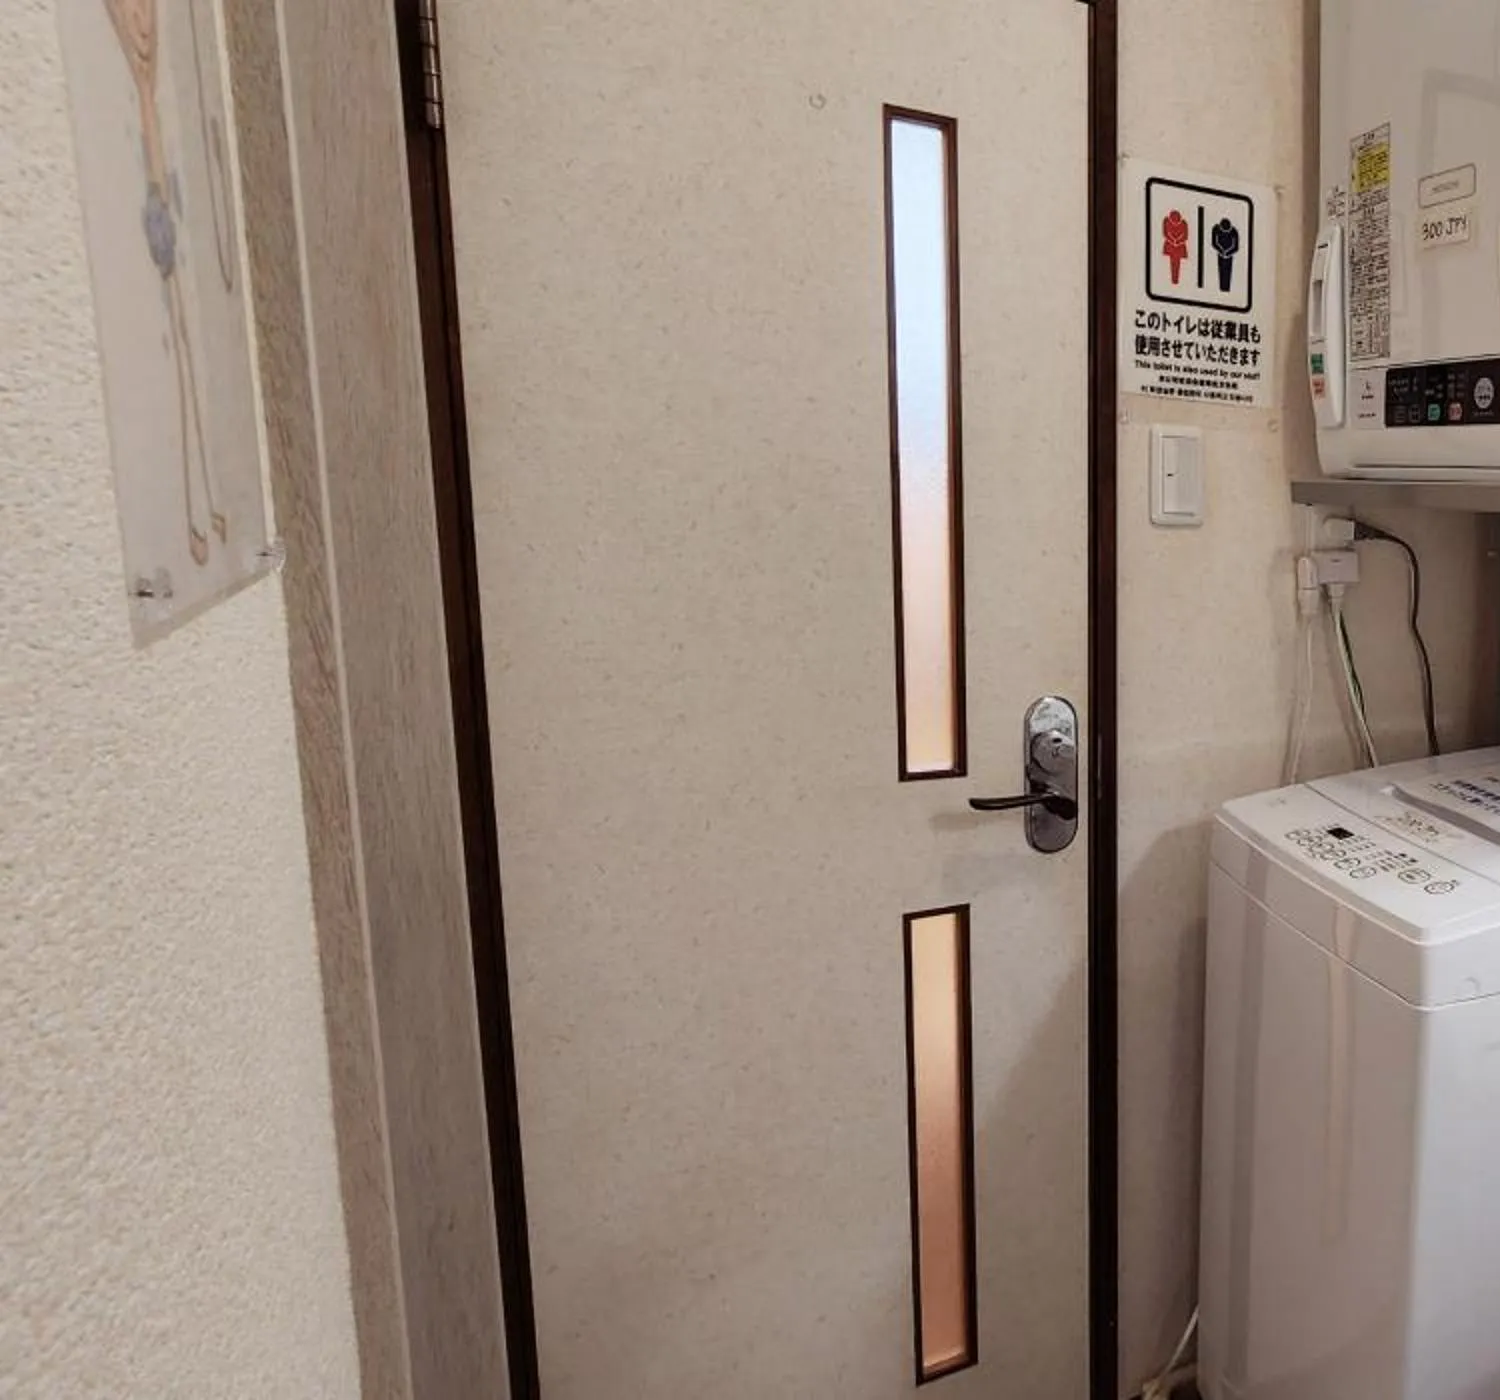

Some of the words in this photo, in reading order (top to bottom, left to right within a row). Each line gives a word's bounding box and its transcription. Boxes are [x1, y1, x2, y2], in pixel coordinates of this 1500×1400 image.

[1422, 219, 1443, 241] 300
[1446, 215, 1468, 237] JPY
[1135, 309, 1261, 343] このトイレは従業員も
[1135, 334, 1261, 366] 使用させていただきます
